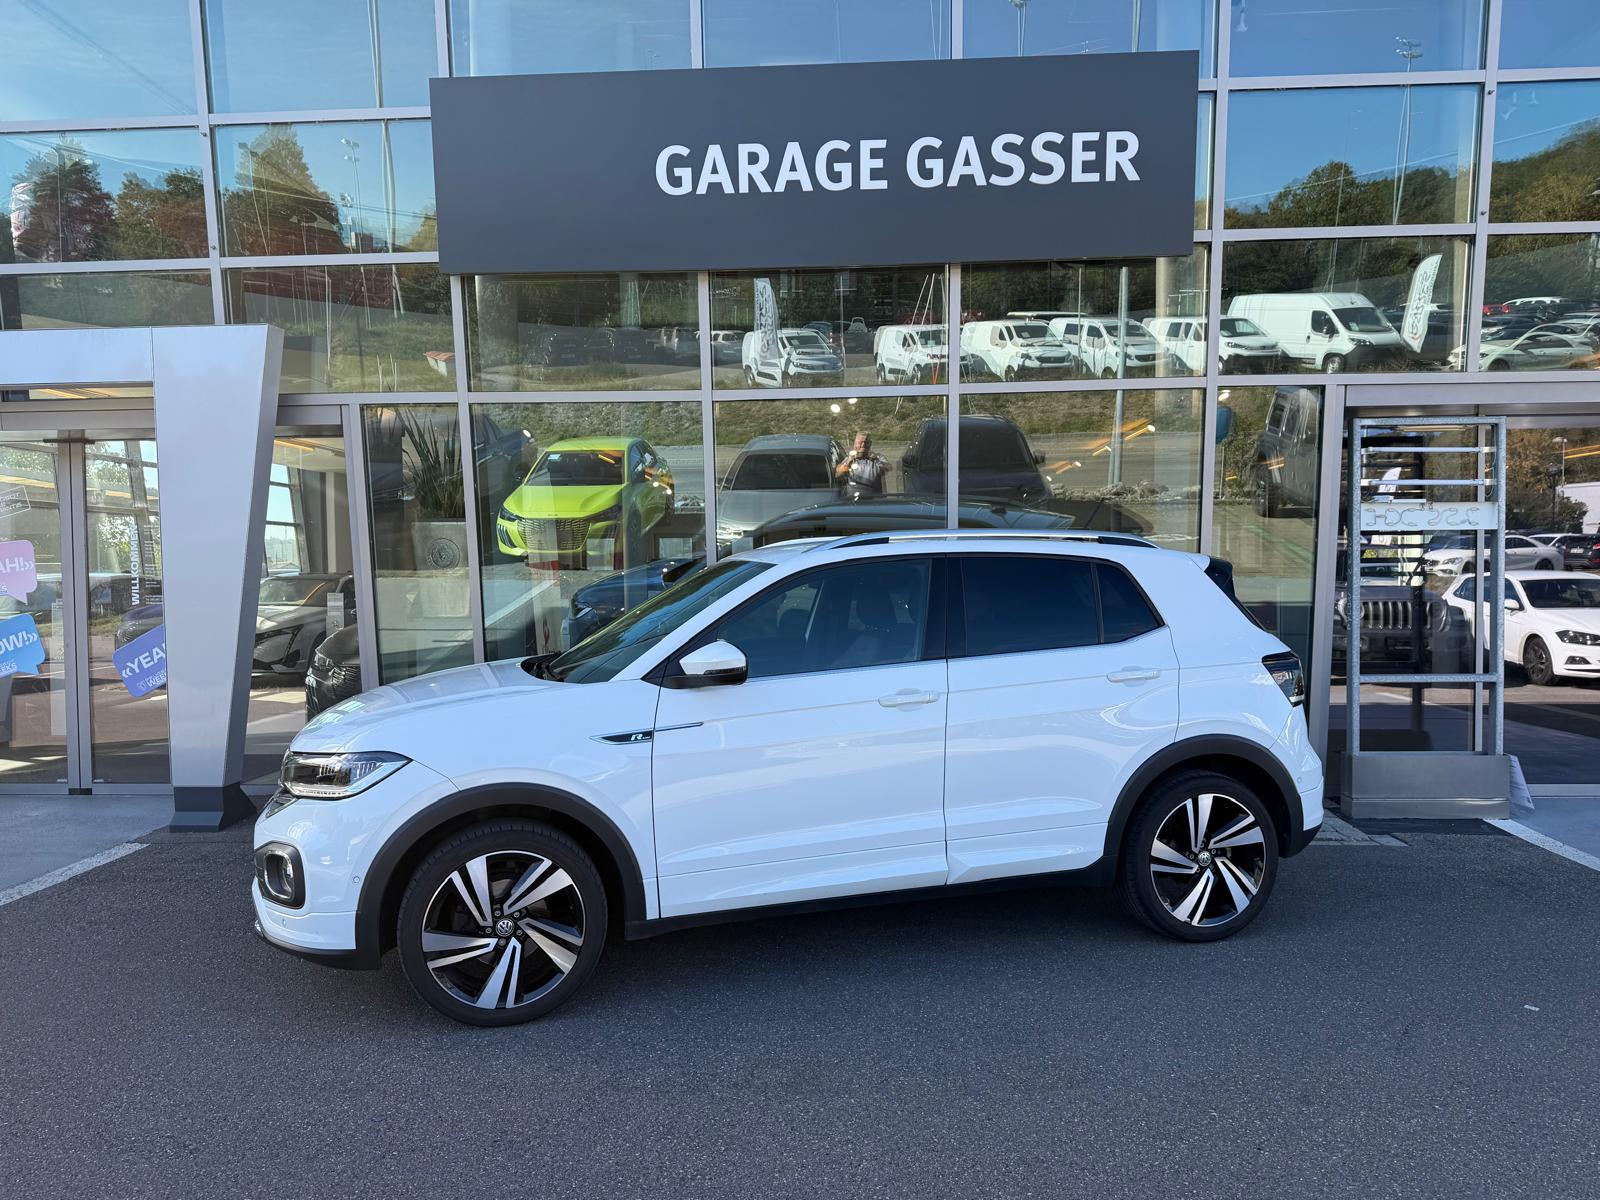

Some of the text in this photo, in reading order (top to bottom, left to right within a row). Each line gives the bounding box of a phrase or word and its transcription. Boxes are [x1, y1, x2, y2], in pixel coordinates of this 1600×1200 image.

[655, 130, 1140, 196] GARAGE GASSER
[130, 524, 140, 606] WILLKOMMEN
[122, 642, 166, 678] «YEA
